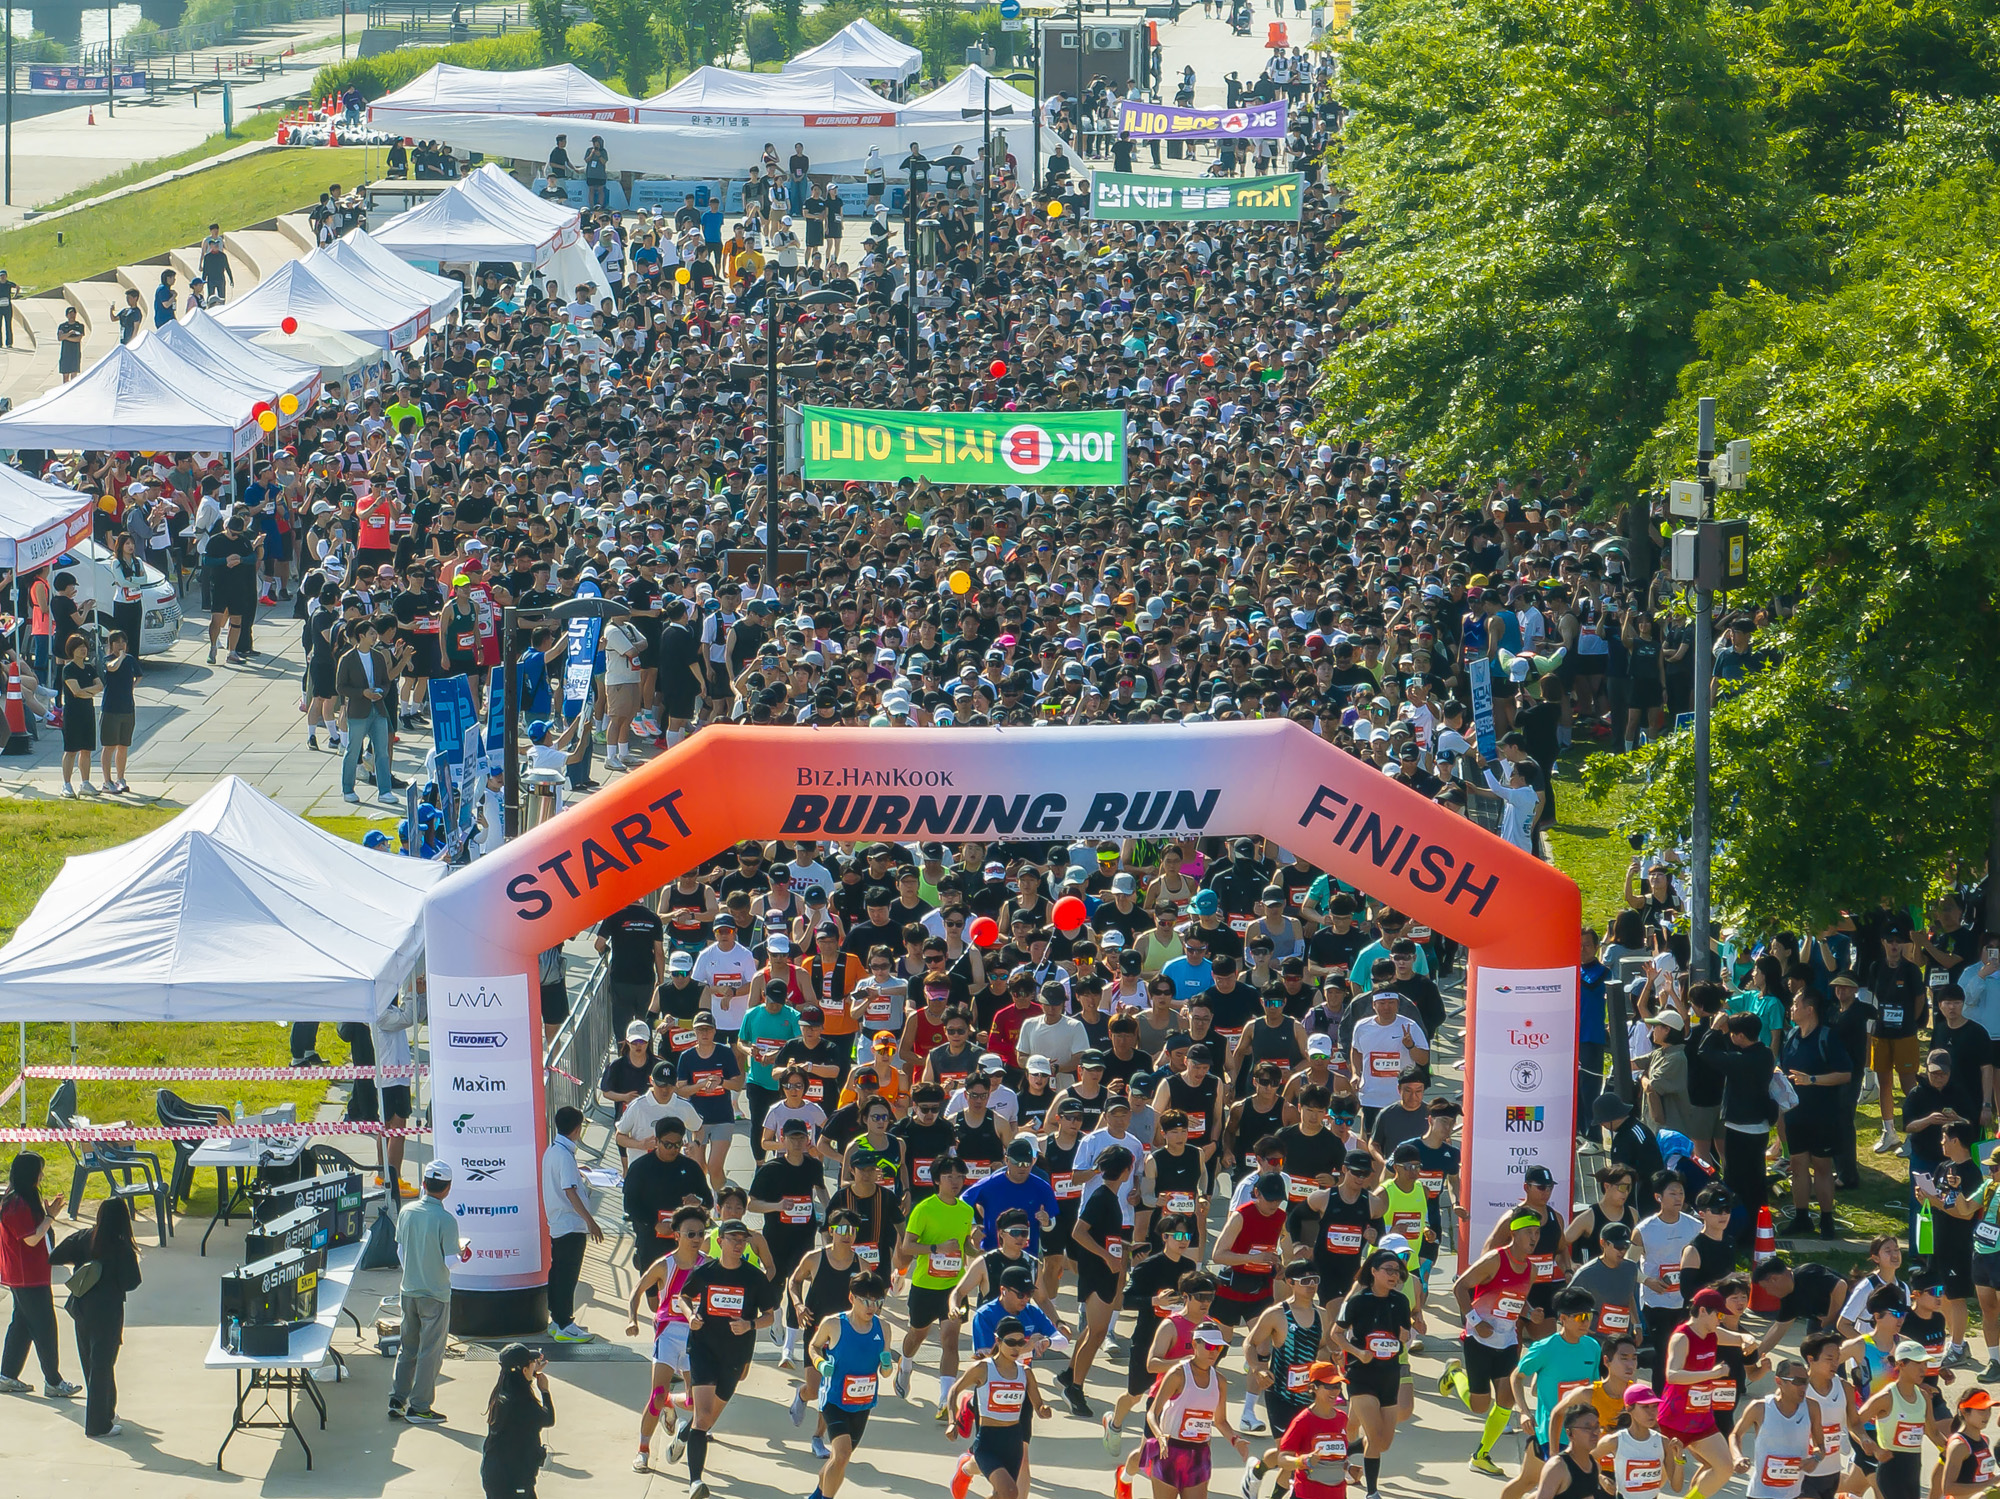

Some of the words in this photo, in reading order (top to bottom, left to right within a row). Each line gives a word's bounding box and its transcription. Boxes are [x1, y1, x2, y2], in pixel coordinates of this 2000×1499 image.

[815, 116, 859, 125] BURNING
[860, 115, 883, 124] RUN
[779, 794, 1068, 836] BURNING
[1079, 789, 1221, 833] RUN
[506, 788, 692, 920] START
[1298, 784, 1500, 918] FINISH
[452, 1035, 498, 1044] FAVONEX
[1507, 1029, 1549, 1050] Tage
[453, 1075, 506, 1091] Maxim
[1507, 1108, 1530, 1120] BE-
[467, 1125, 512, 1134] NEWTREE
[1506, 1120, 1544, 1132] KIND
[1509, 1147, 1538, 1157] TOUS
[461, 1157, 506, 1168] Reebok
[1507, 1165, 1530, 1175] JOU
[306, 1182, 347, 1205] SAMIK
[341, 1196, 358, 1208] 10km
[292, 1219, 319, 1244] SAMIK
[476, 1248, 521, 1259] 롯데웰푸드
[271, 1261, 305, 1288] SAMIK
[301, 1278, 313, 1289] 5km
[722, 1296, 741, 1304] 2336
